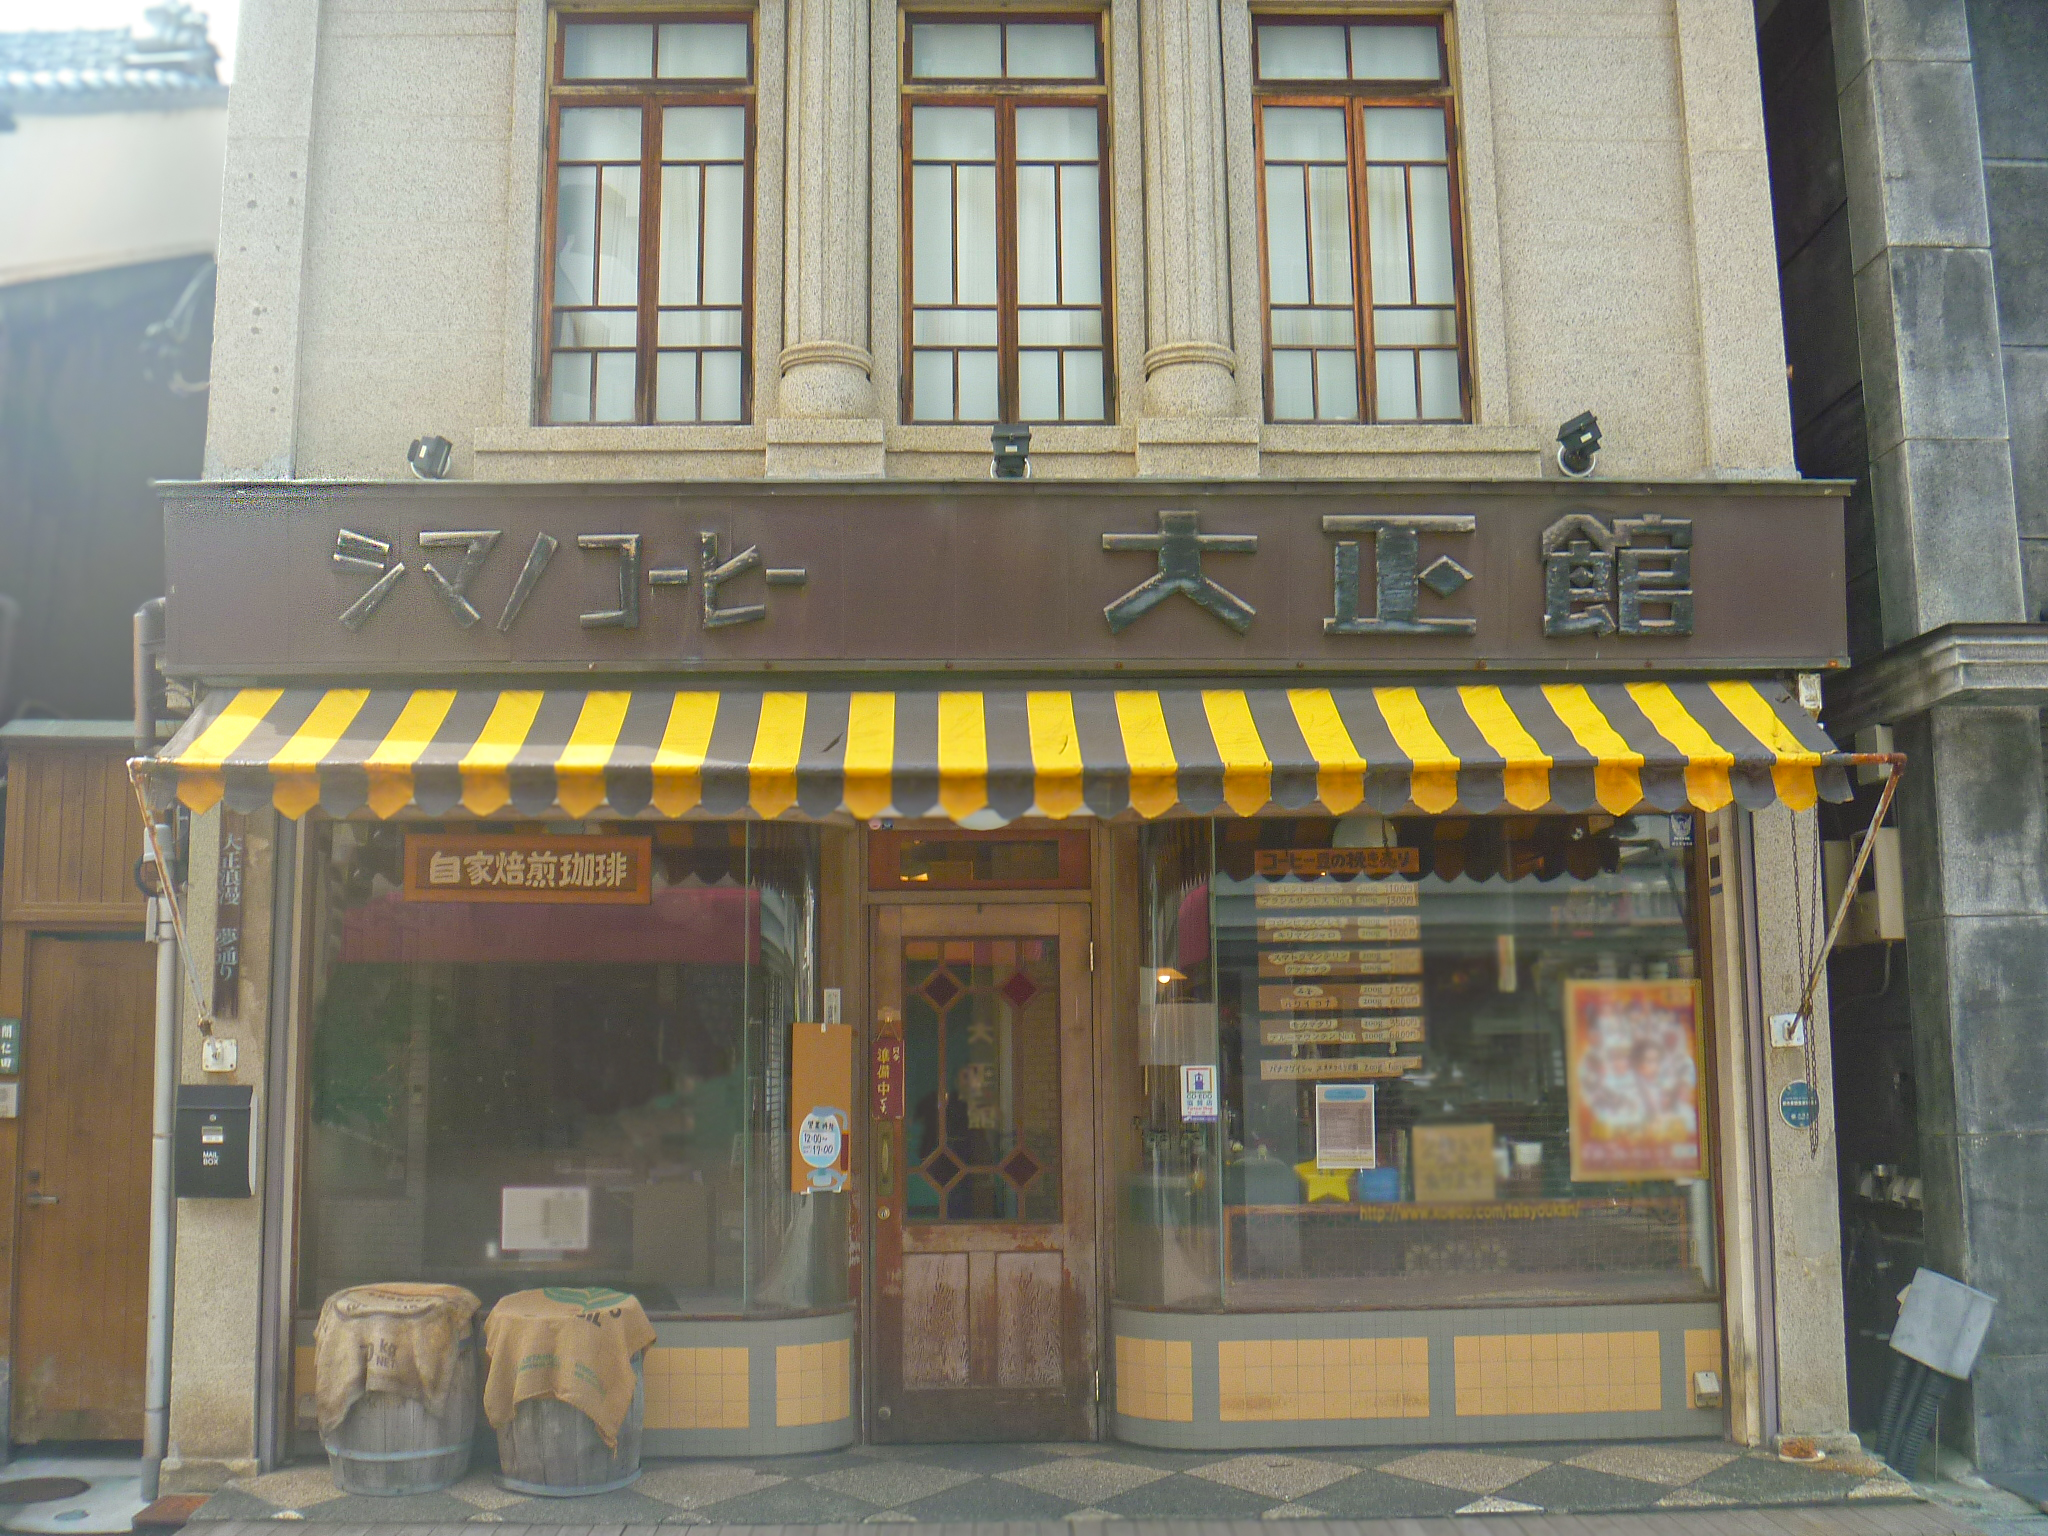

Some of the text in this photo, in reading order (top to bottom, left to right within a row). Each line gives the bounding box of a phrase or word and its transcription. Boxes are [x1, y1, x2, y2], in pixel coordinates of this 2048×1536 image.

[332, 510, 1693, 637] シマノコーヒー 大正館
[429, 850, 628, 888] 自家焙煎珈琲
[1278, 931, 1336, 940] キリマンジャロ
[203, 1150, 217, 1158] MAIL
[203, 1158, 218, 1166] BOX
